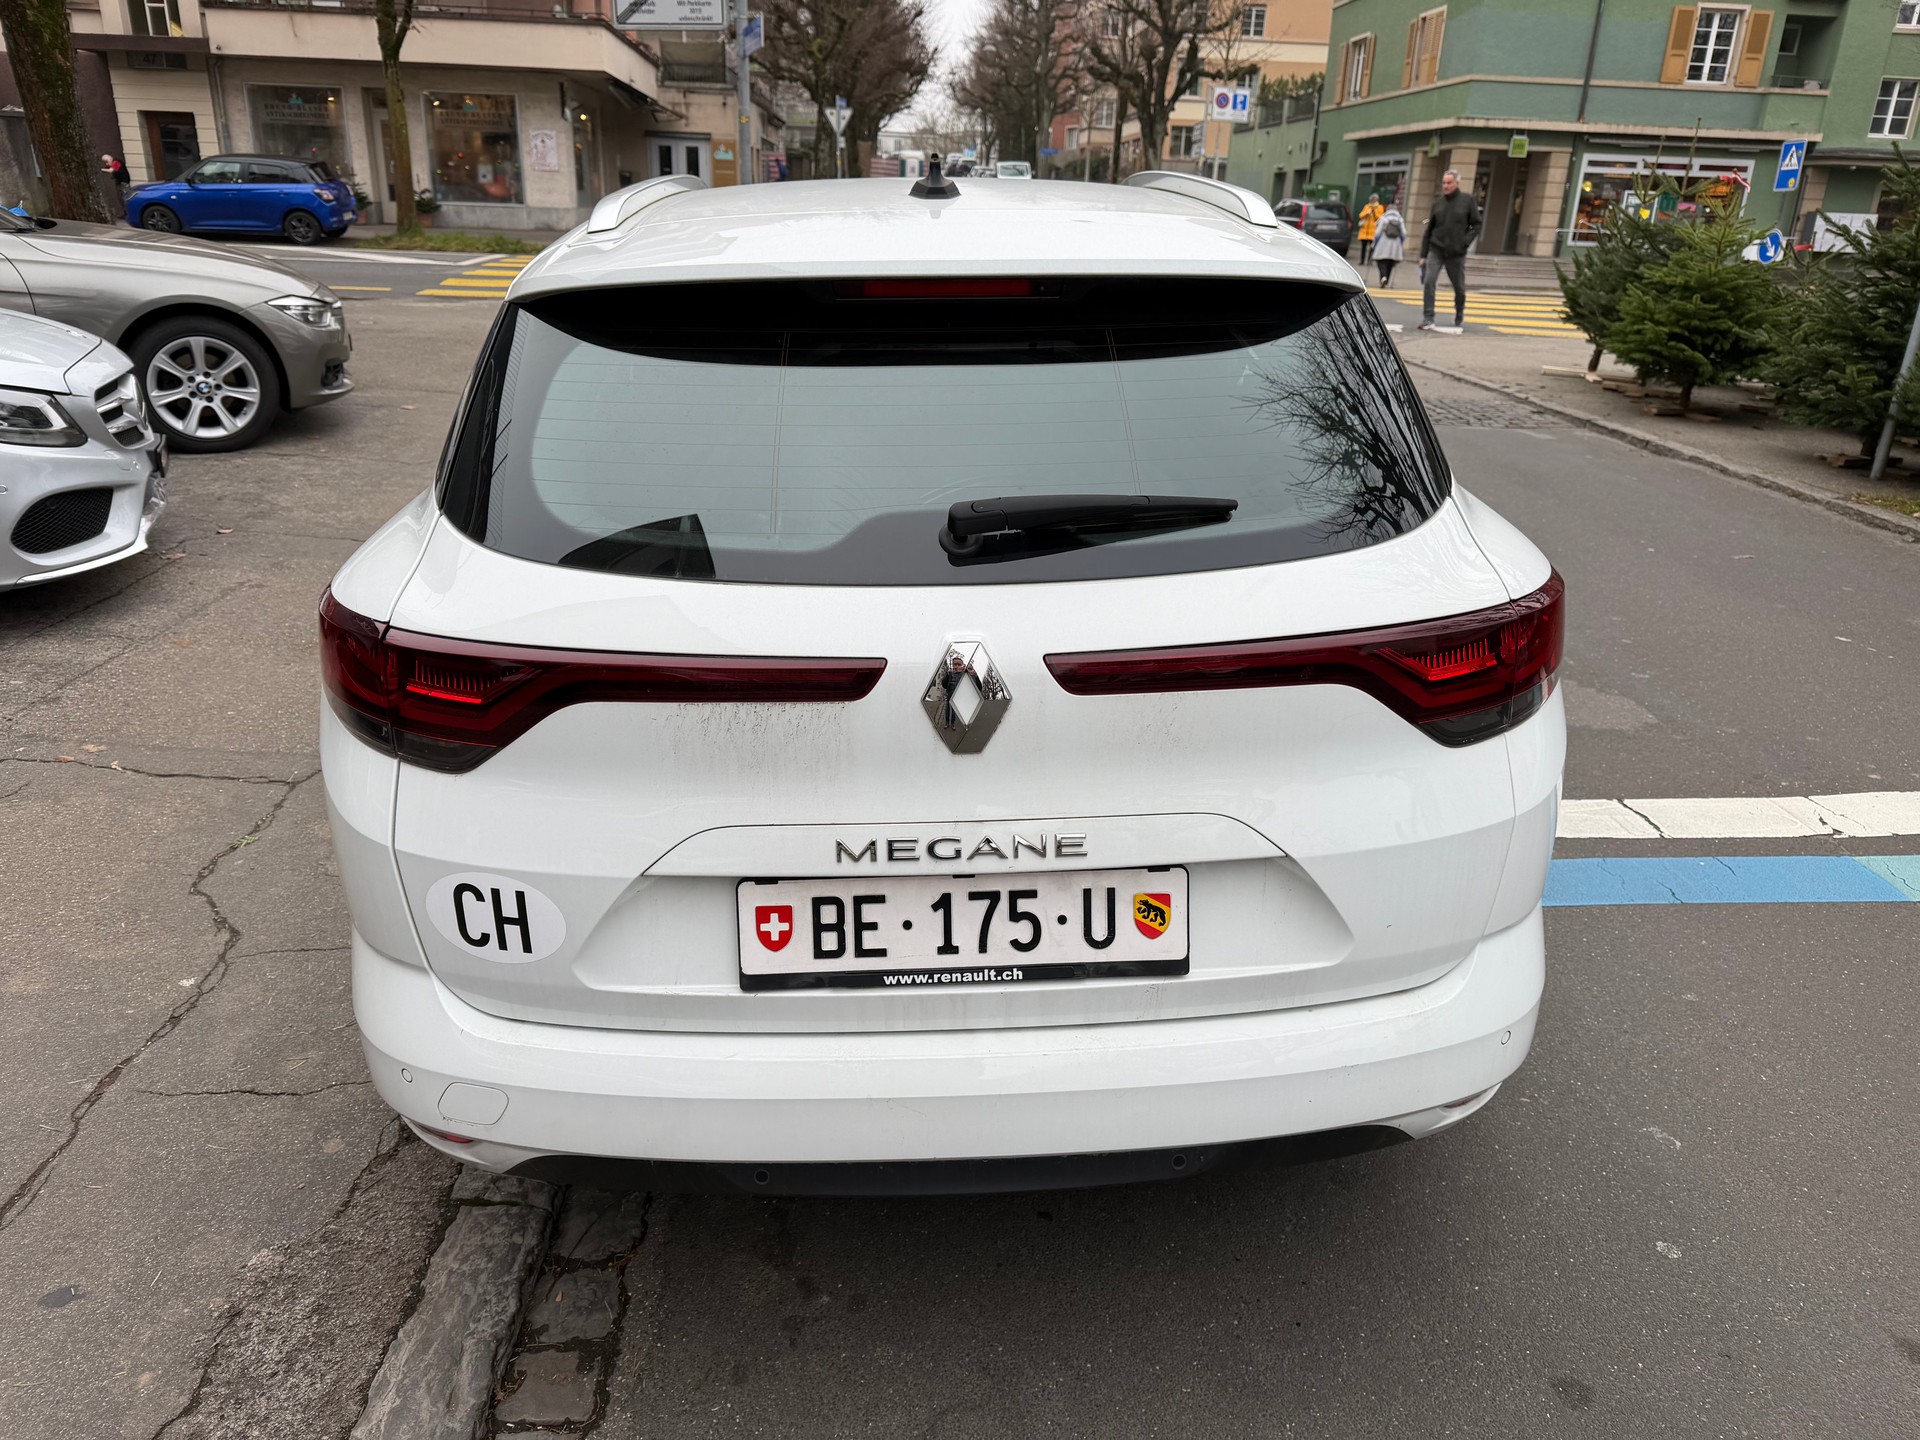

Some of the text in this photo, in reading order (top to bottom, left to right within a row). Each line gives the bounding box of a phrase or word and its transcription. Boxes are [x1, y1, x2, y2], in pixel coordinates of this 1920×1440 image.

[143, 53, 156, 65] 47
[835, 832, 1088, 863] MEGANE
[453, 882, 533, 954] CH
[883, 967, 1023, 985] www.renault.ch
